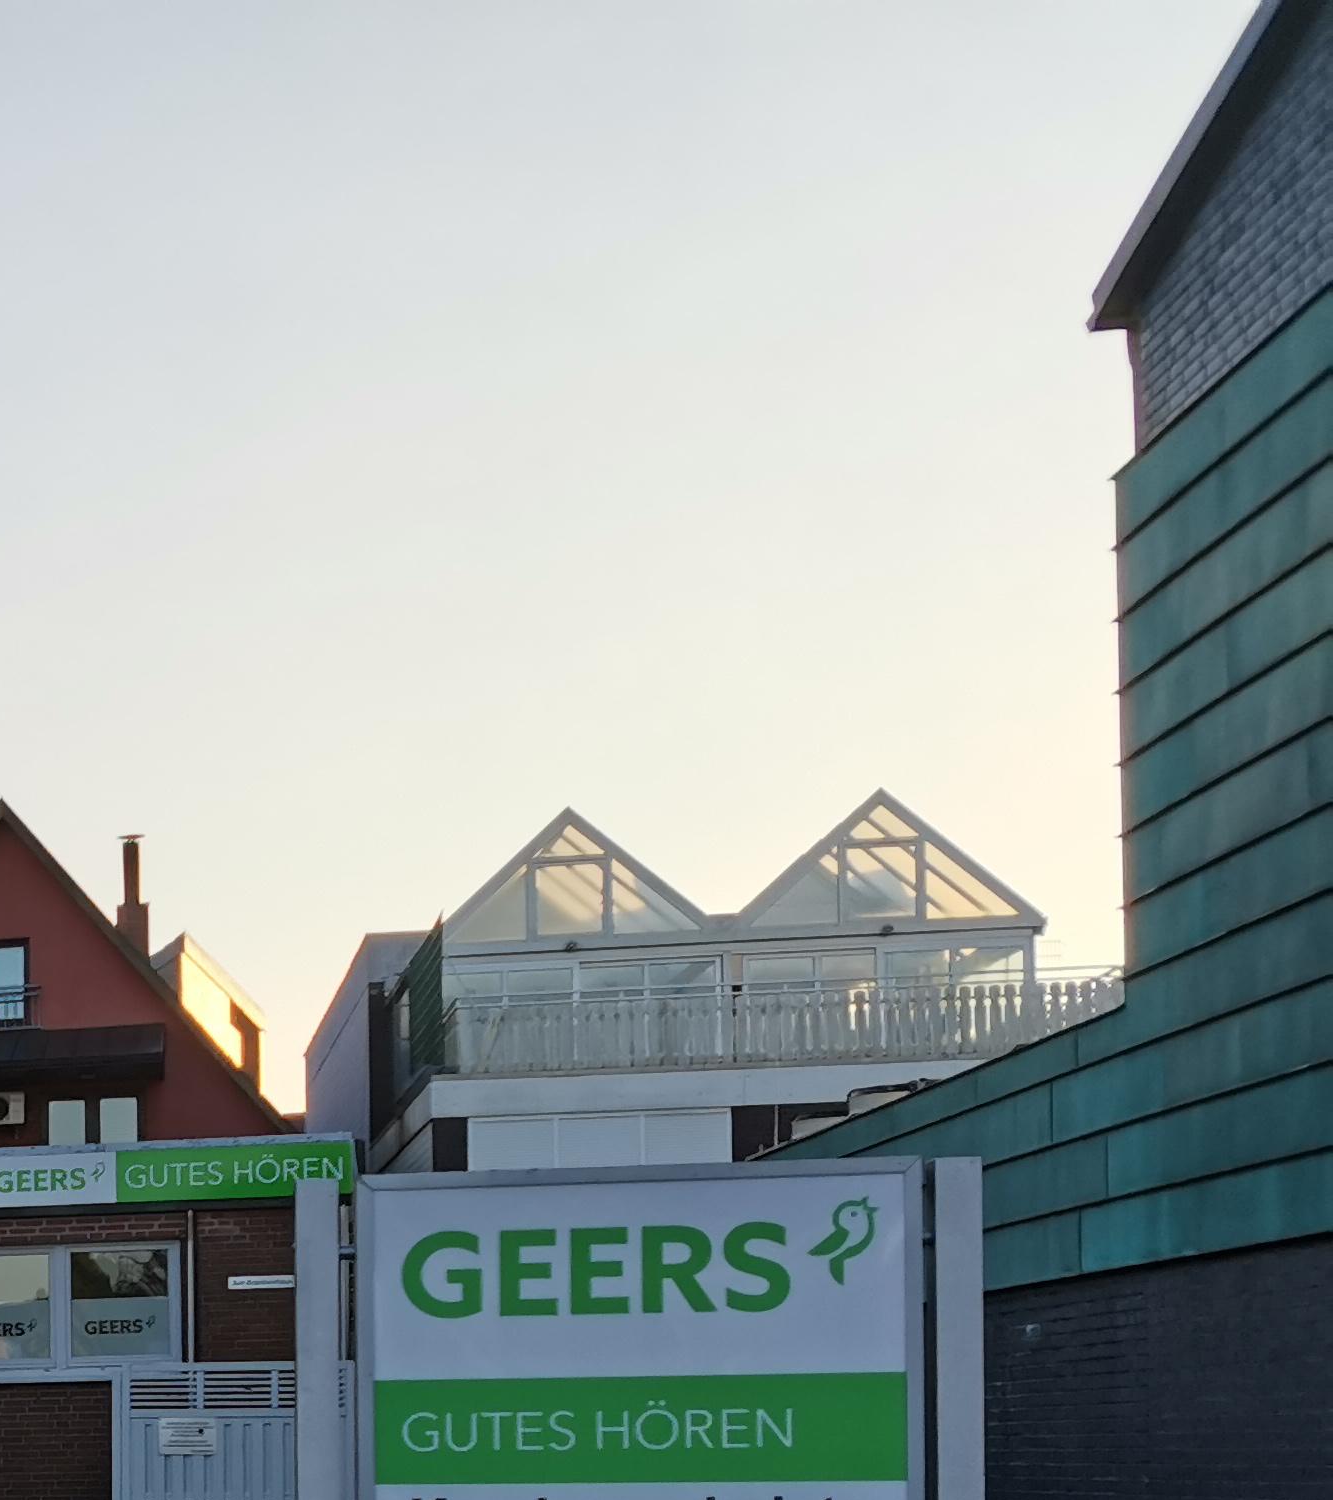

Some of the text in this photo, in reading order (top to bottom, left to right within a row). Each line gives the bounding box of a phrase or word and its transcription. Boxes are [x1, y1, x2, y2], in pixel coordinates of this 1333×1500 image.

[124, 1161, 224, 1190] GUTES
[233, 1155, 345, 1185] HÖREN
[400, 1221, 792, 1320] GEERS
[84, 1318, 144, 1336] GEERS
[400, 1399, 794, 1453] GUTES HÖREN
